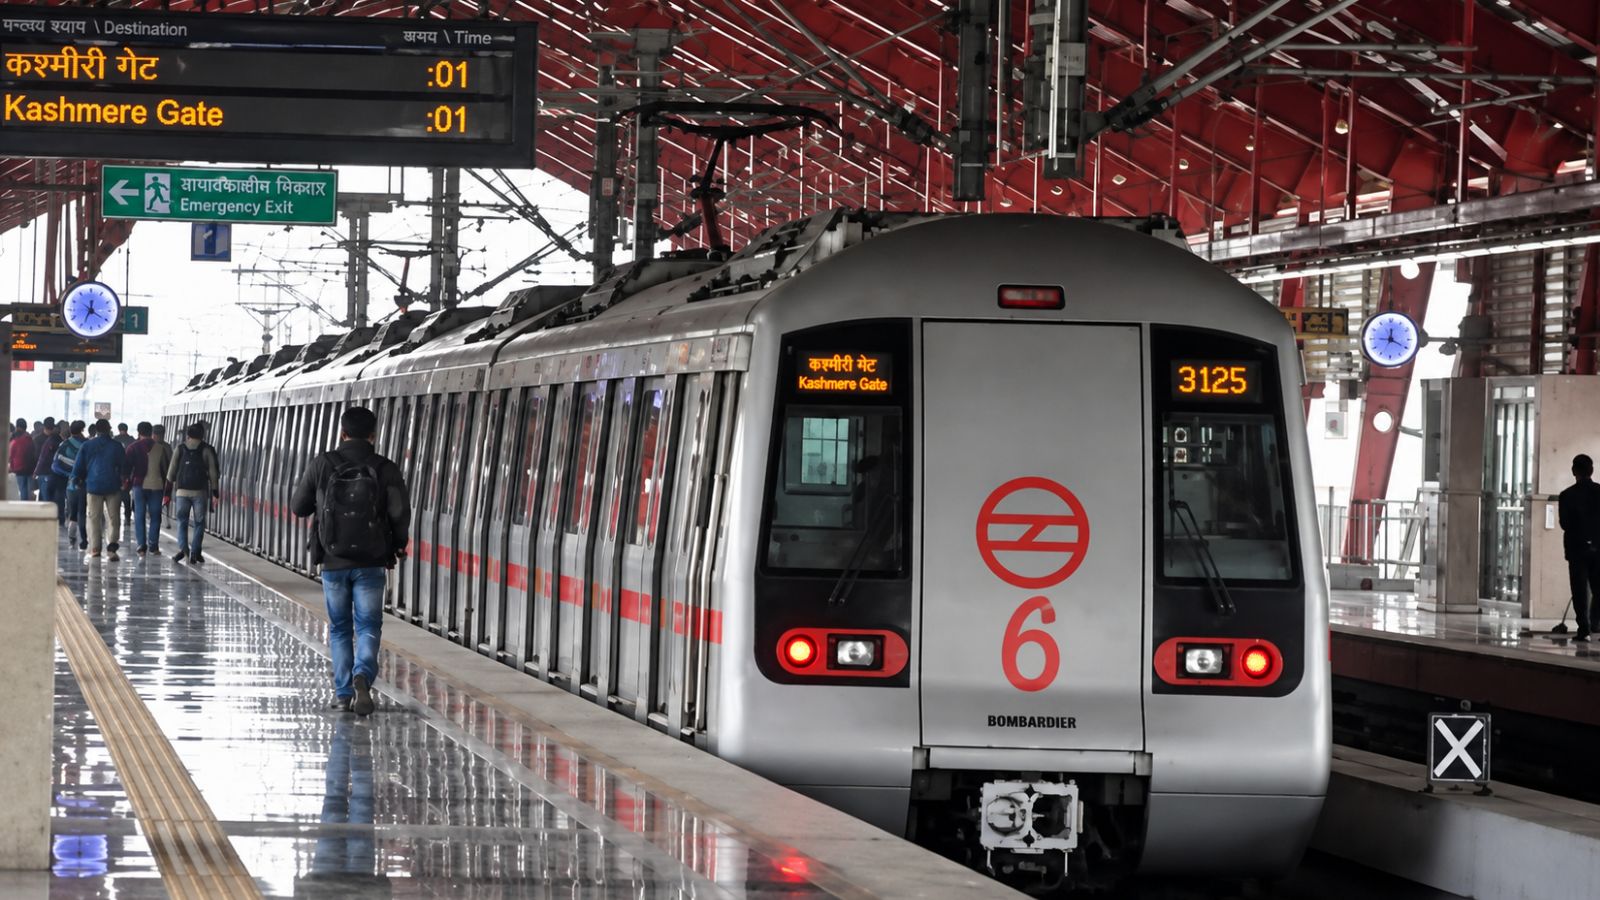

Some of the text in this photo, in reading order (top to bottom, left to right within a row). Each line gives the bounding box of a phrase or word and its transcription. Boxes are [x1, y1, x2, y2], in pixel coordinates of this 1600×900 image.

[104, 20, 188, 37] Destination
[454, 30, 492, 44] Time
[5, 45, 160, 81] कश्मीरी गेट
[427, 60, 468, 88] :01
[4, 94, 224, 127] Kashmere Gate
[426, 105, 466, 133] :01
[180, 197, 294, 217] Emergency Exit
[798, 375, 888, 391] Kashmere Gate
[1178, 366, 1247, 394] 3125
[1001, 594, 1061, 692] 6
[987, 714, 1077, 729] BOMBARDIER
